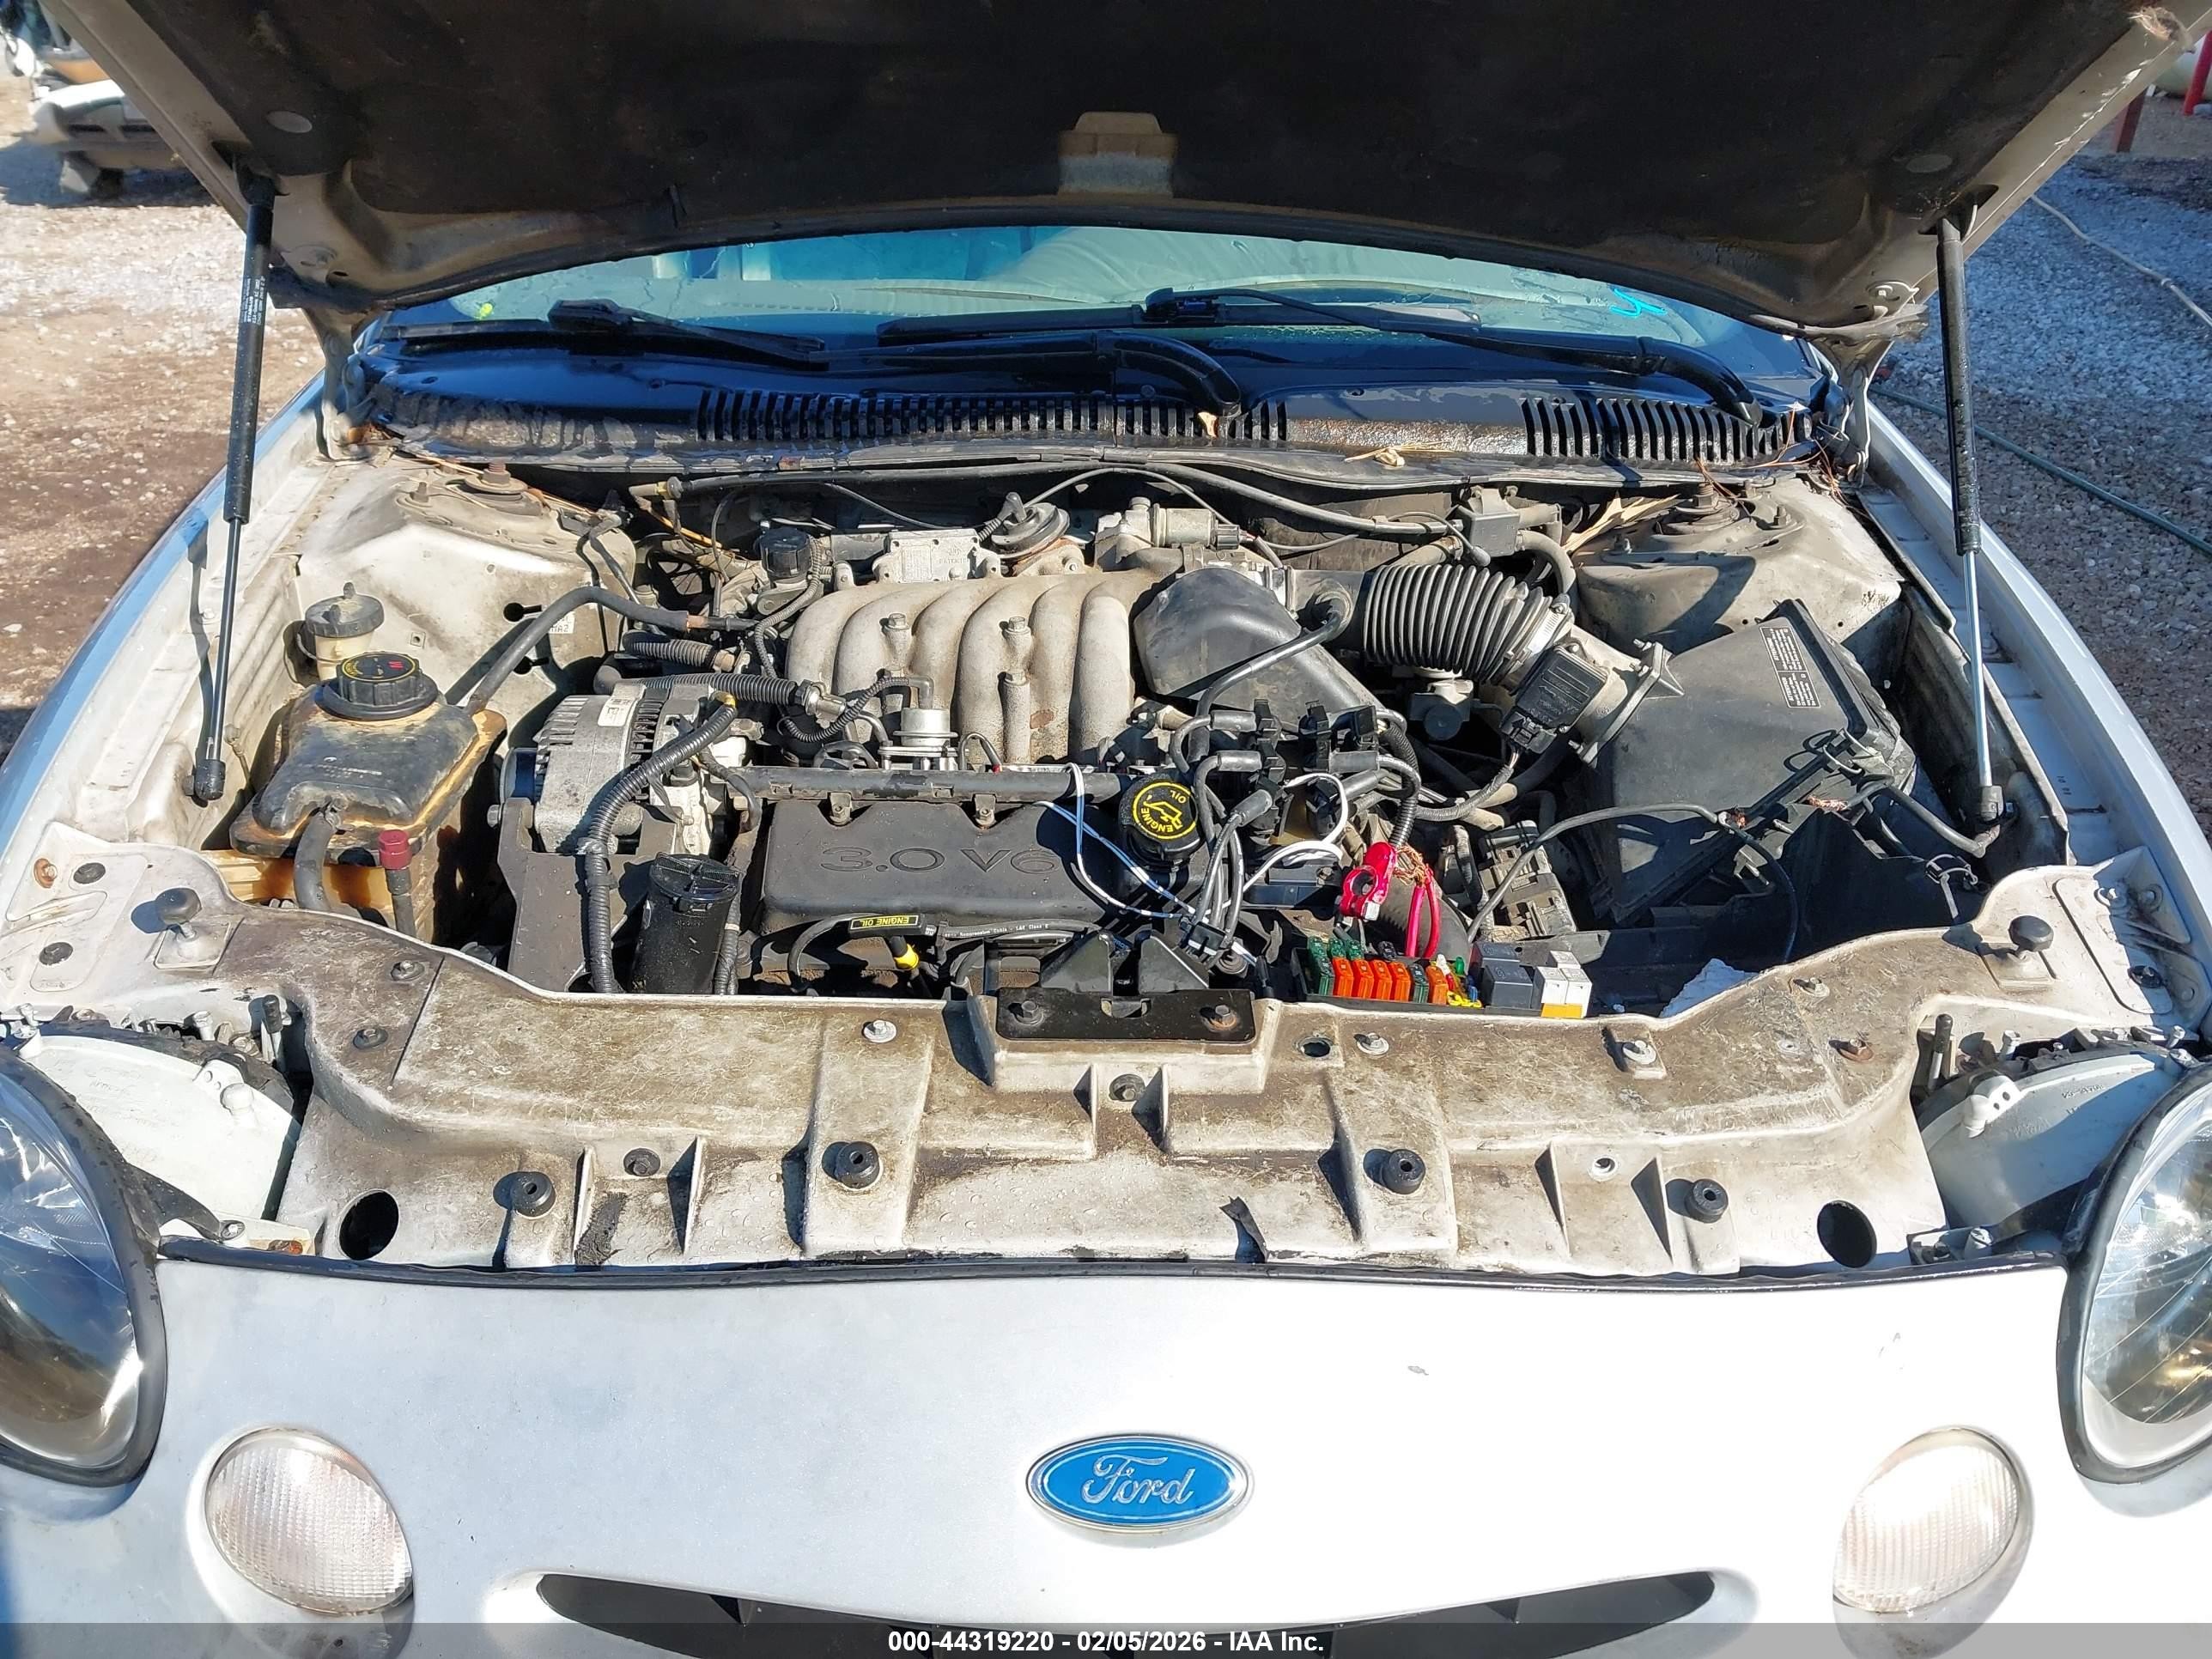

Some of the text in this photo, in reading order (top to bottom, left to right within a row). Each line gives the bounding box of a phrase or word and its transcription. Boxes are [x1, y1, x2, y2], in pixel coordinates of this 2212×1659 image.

[1170, 789, 1187, 805] OIL
[1140, 807, 1174, 833] ENGINE
[819, 846, 1062, 874] 3.0 V6
[860, 916, 909, 927] ENGINE OIL
[1080, 1454, 1196, 1504] Ford
